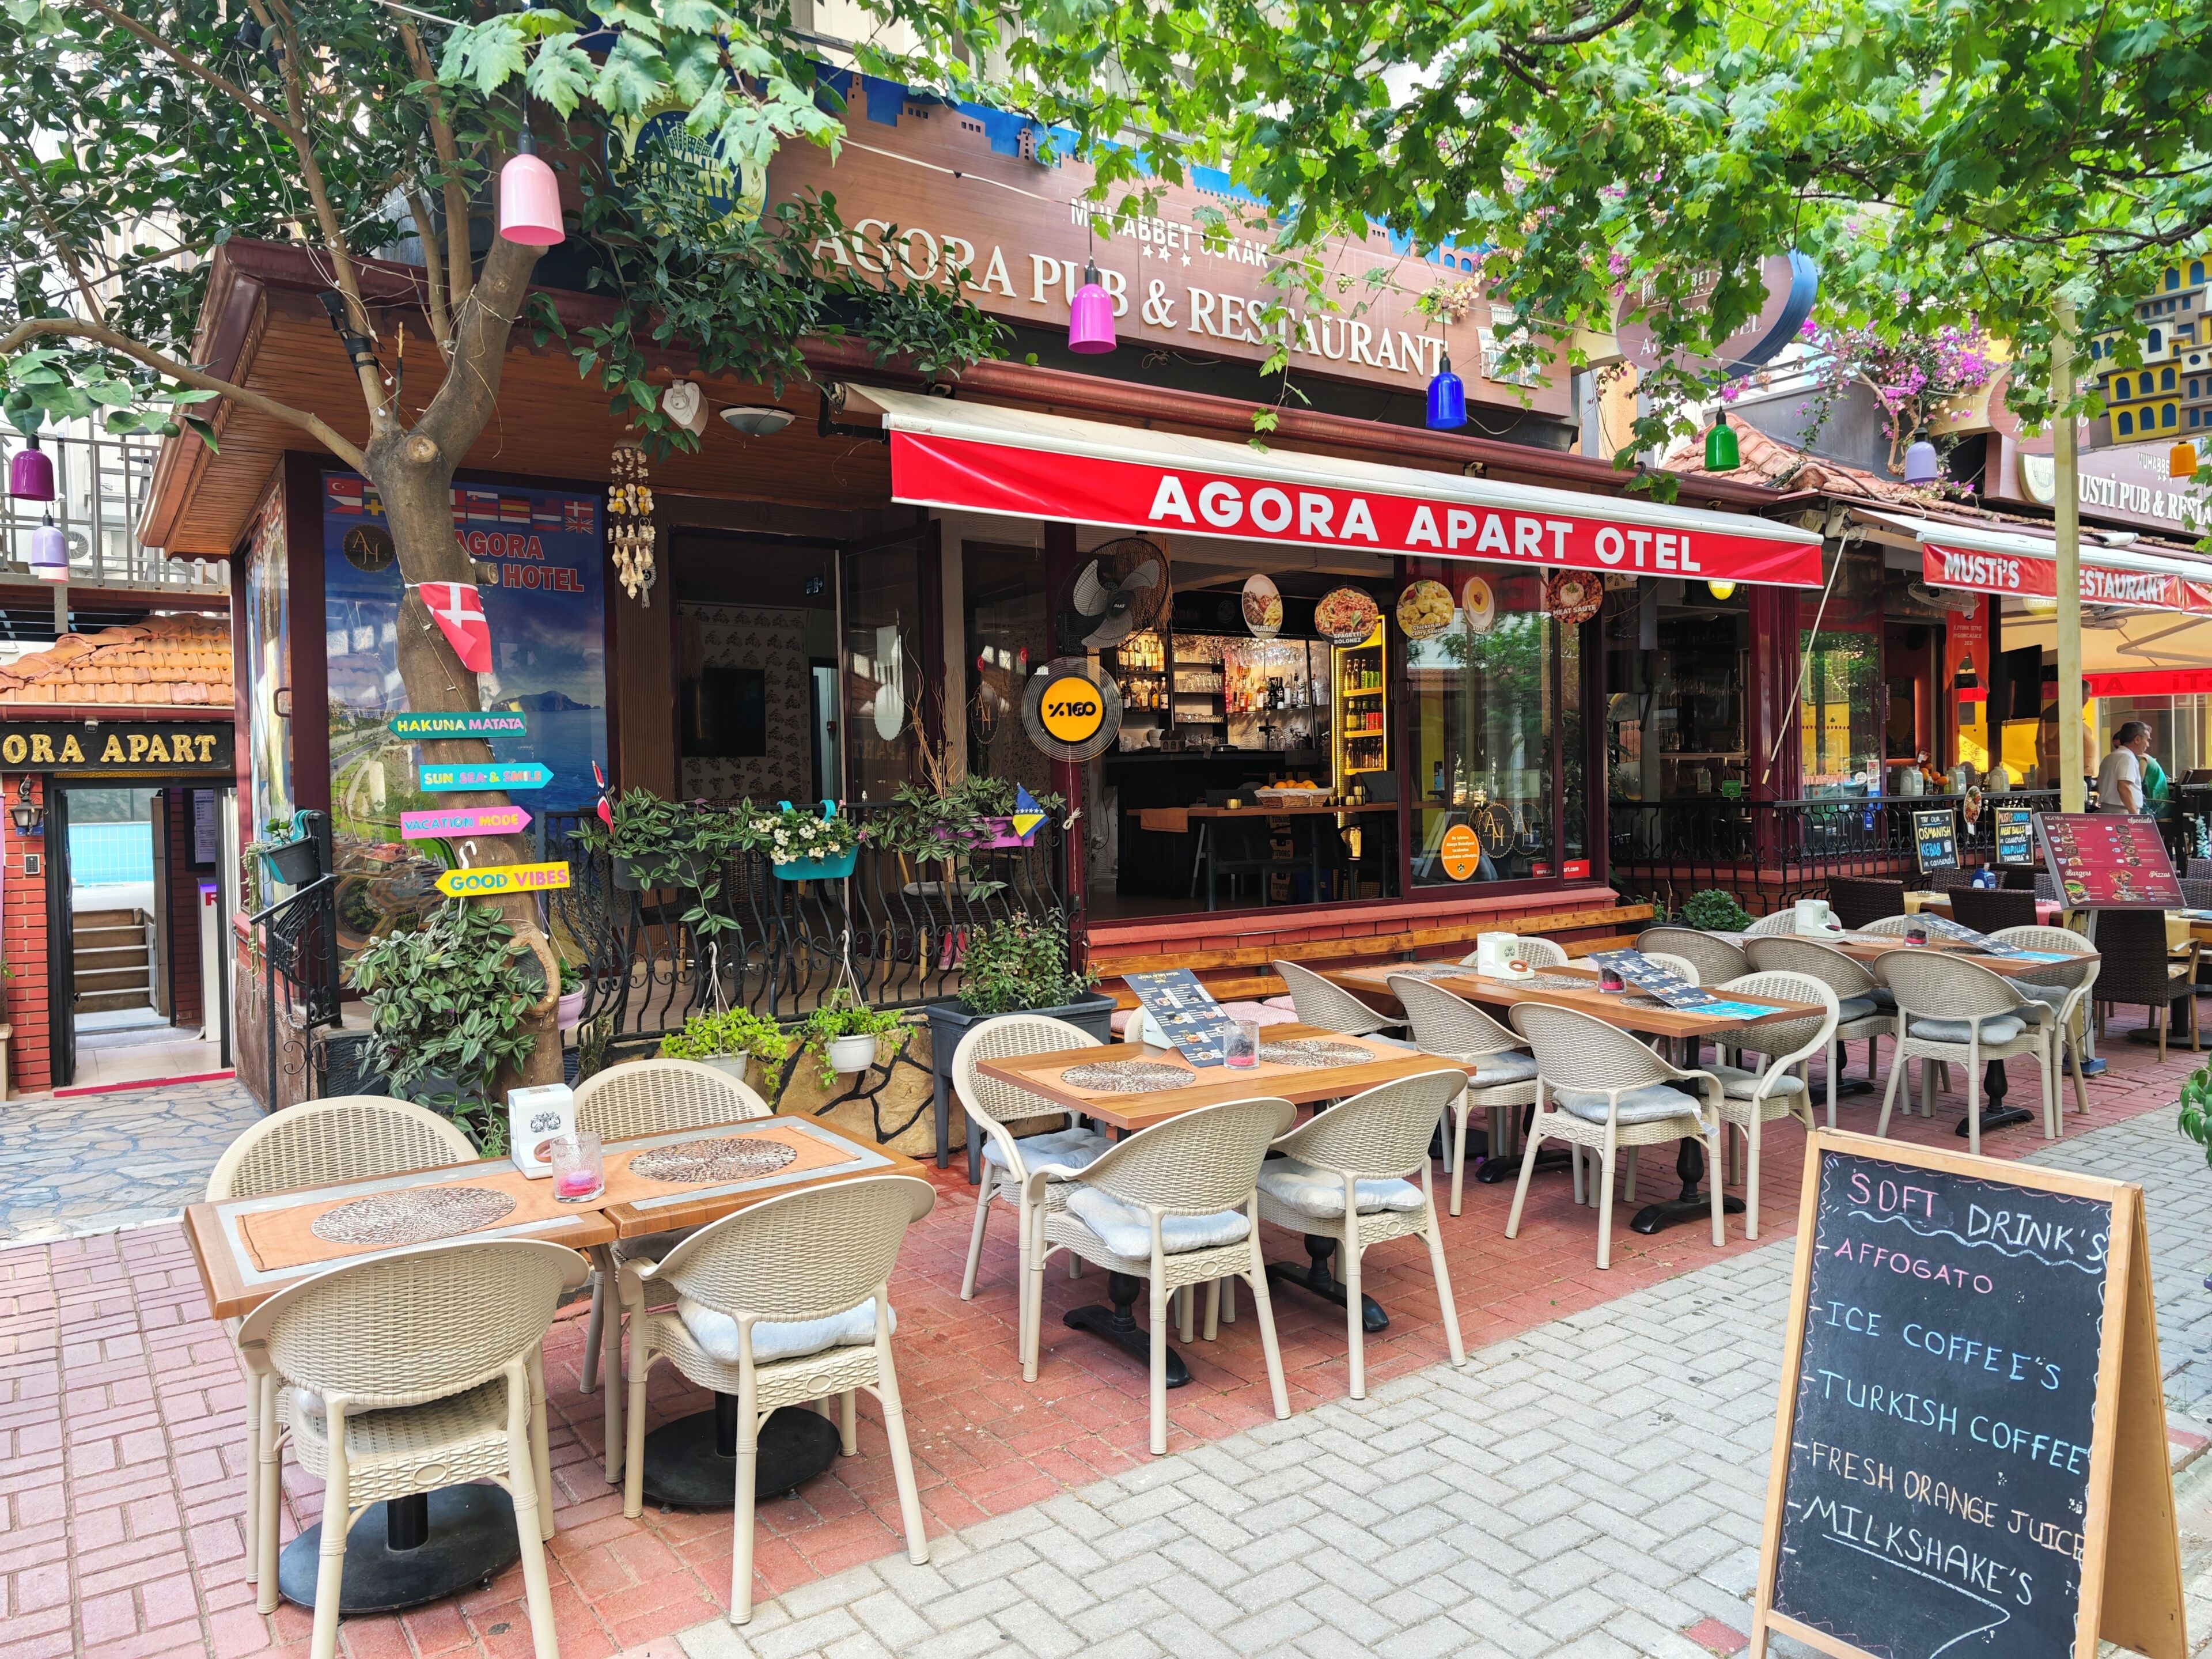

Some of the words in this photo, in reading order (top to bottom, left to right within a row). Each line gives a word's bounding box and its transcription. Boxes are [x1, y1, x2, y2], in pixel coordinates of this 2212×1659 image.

[811, 217, 1017, 298] AGORA
[1141, 279, 1178, 329] &
[1187, 286, 1449, 379] RESTAURANT
[2138, 452, 2170, 475] MUHABBE
[2077, 472, 2116, 507] USTİ
[2118, 482, 2150, 514] PUB
[2152, 490, 2165, 517] &
[1149, 476, 1380, 543] AGORA
[1406, 506, 1573, 560] APART
[1594, 528, 1701, 573] OTEL
[503, 563, 585, 592] HOTEL
[2079, 570, 2166, 603] ESTAURANT
[1552, 608, 1571, 616] MEAT
[1252, 624, 1278, 632] MEATBALL
[397, 718, 467, 732] HAKUNA
[468, 717, 524, 730] MATATA
[3, 734, 86, 764] ORA
[100, 734, 217, 763] APART
[423, 772, 453, 785] SUN
[459, 772, 486, 784] SEA
[489, 771, 501, 783] &
[503, 770, 542, 782] SMILE
[404, 816, 474, 831] VACATION
[479, 813, 519, 827] MODE
[1918, 826, 1952, 840] OSMANISH
[2000, 826, 2011, 836] MEAT
[2012, 825, 2025, 835] BALLS
[1920, 842, 1941, 857] KEBAB
[1923, 859, 1929, 868] in
[2065, 869, 2092, 878] Burgers
[450, 874, 507, 891] GOOD
[514, 869, 567, 887] VIBES
[1847, 1171, 1939, 1218] SOFT
[1968, 1203, 2108, 1262] DRINK'S
[1834, 1238, 1994, 1294] AFFOGATO
[1824, 1301, 1881, 1337] ICE
[1816, 1369, 1958, 1437] TURKISH
[1970, 1415, 2089, 1475] COFFEE
[1811, 1442, 1895, 1493] FRESH
[1904, 1469, 1999, 1528] ORANGE
[2007, 1509, 2087, 1561] JUICE
[1802, 1495, 2033, 1606] MILKSHAKE'S
